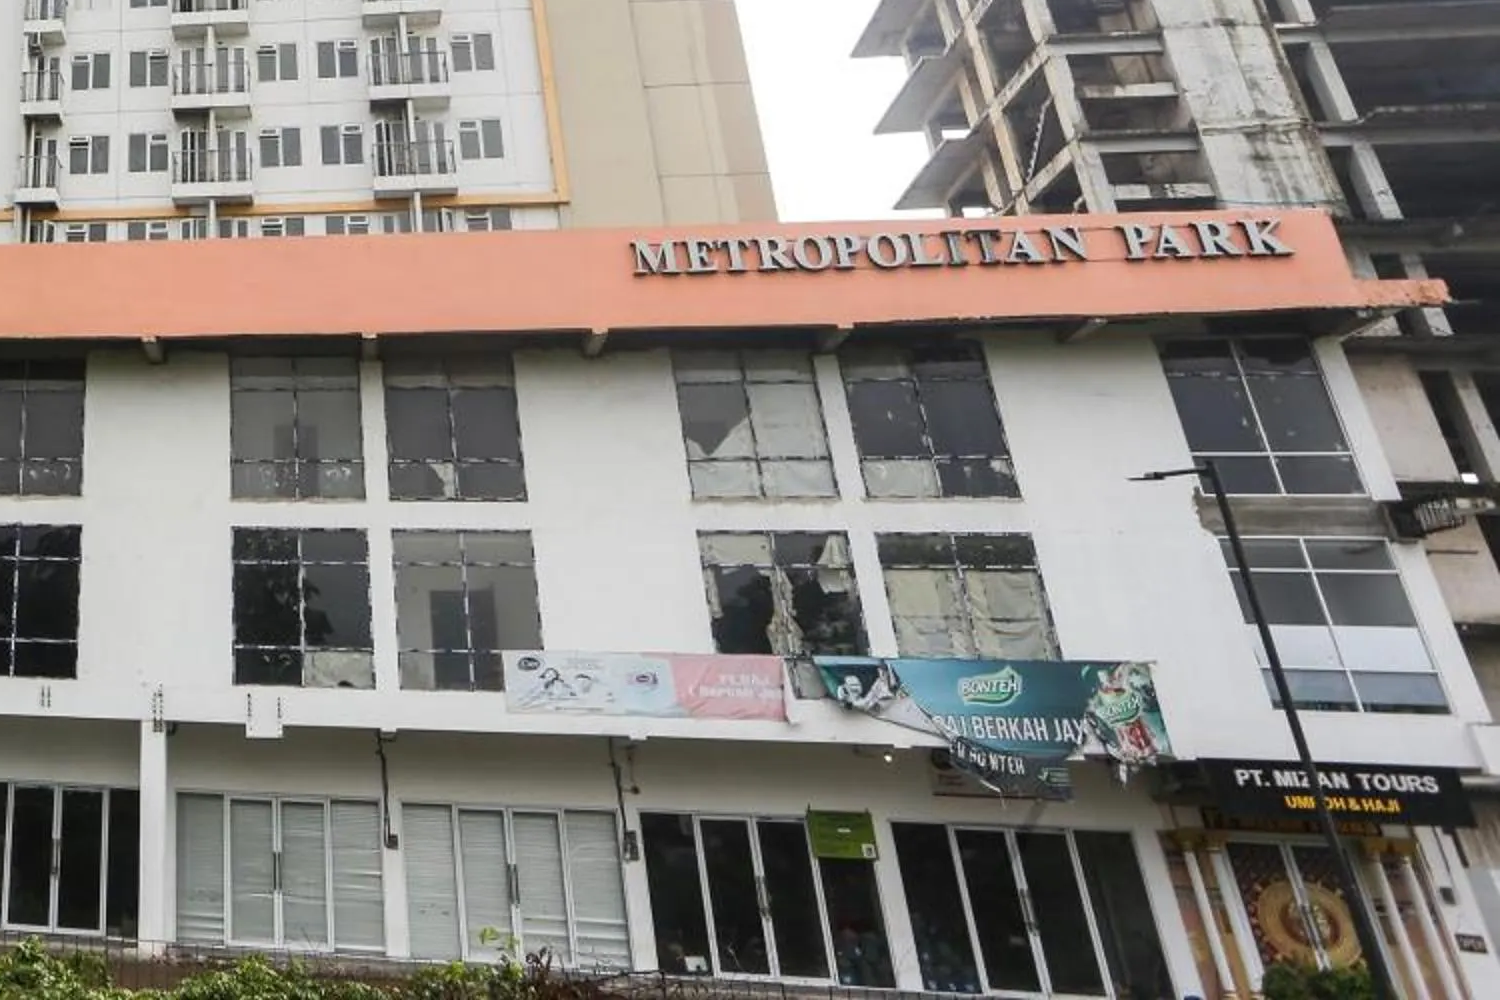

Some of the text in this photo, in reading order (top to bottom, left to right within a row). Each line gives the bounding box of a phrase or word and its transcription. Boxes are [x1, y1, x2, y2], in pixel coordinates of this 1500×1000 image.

[630, 217, 1295, 276] METROPOLITAN PARK
[961, 677, 1020, 697] BONTEH
[971, 715, 1049, 741] BERKAH
[1234, 769, 1440, 794] PT. MIZAN TOURS
